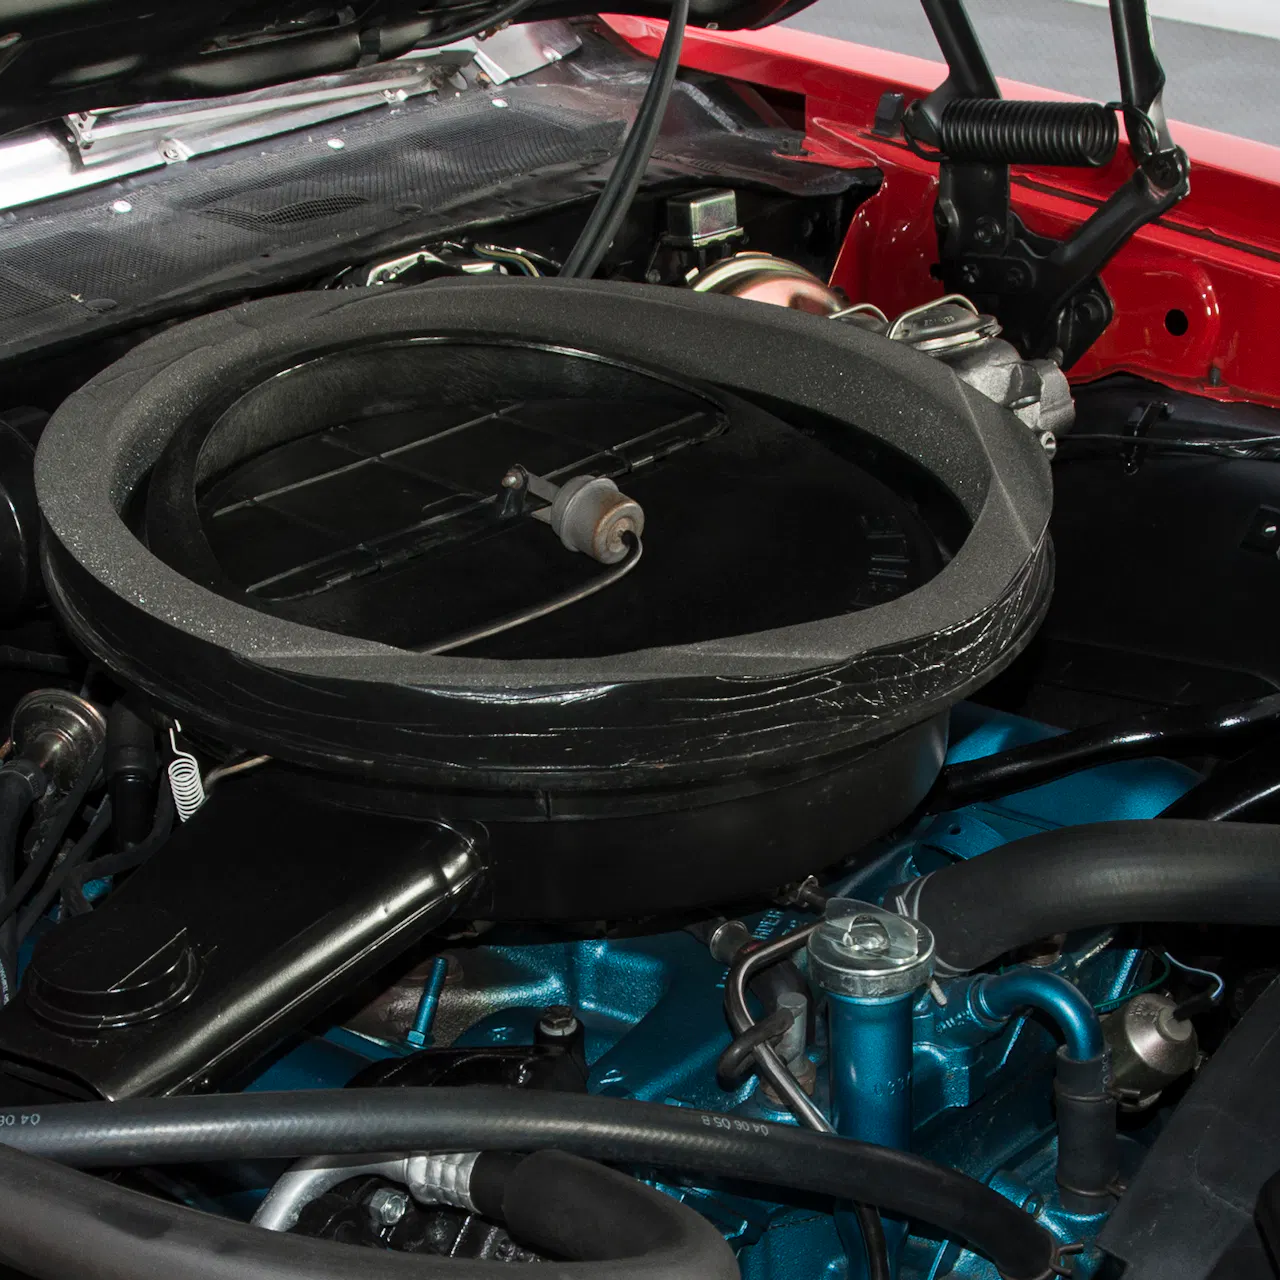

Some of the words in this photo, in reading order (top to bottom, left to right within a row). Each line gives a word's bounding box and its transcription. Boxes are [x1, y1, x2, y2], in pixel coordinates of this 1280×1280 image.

[21, 1113, 41, 1126] 04
[713, 1116, 731, 1130] 05
[733, 1119, 750, 1132] 06
[752, 1123, 769, 1137] 04
